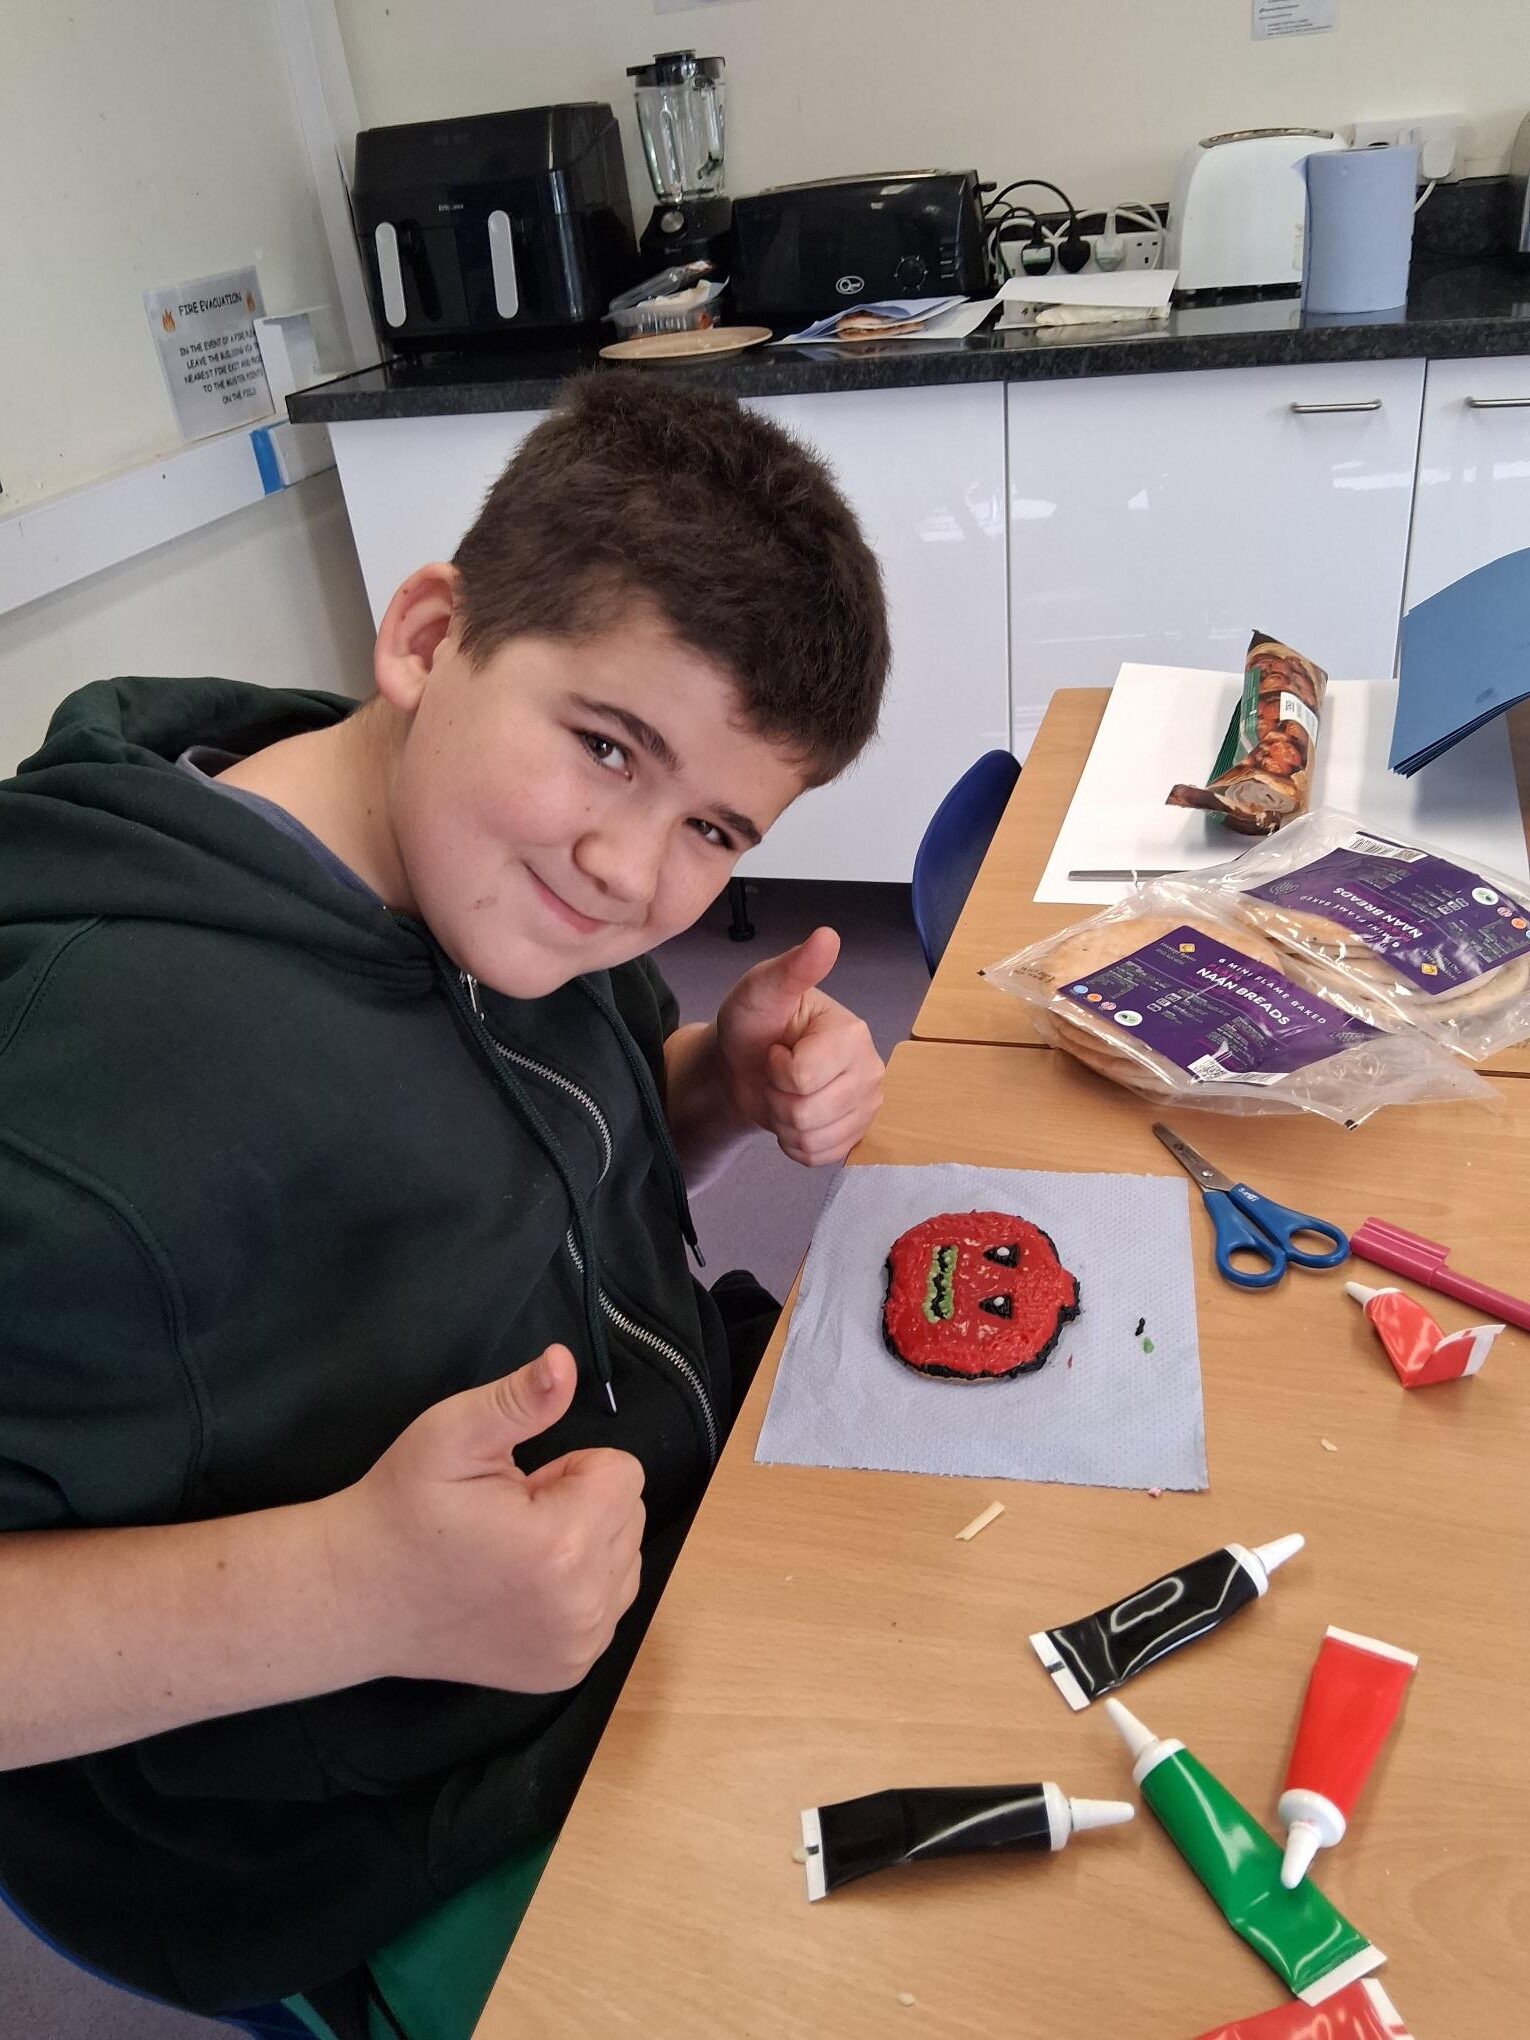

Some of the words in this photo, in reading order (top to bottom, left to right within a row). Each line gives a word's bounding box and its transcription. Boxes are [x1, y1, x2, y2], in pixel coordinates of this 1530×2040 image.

[178, 301, 200, 316] FIRE
[200, 292, 242, 312] EVACUATION
[190, 343, 202, 353] THE
[204, 337, 220, 350] EVENT
[184, 369, 214, 384] NEAREST
[214, 365, 228, 376] FIRE
[227, 361, 240, 372] EXIT
[186, 358, 208, 370] LEAVE
[208, 354, 219, 363] THE
[203, 384, 213, 393] TO
[213, 380, 226, 390] THE
[1299, 895, 1332, 907] BAKED
[1332, 887, 1385, 916] BREADS
[1332, 904, 1366, 923] FLAME
[1382, 914, 1423, 939] NAAN
[1196, 967, 1237, 991] NAAN
[1235, 987, 1291, 1026] BREADS
[1227, 962, 1253, 977] MINI
[1254, 976, 1290, 999] FLAME
[1290, 1000, 1328, 1024] BAKED
